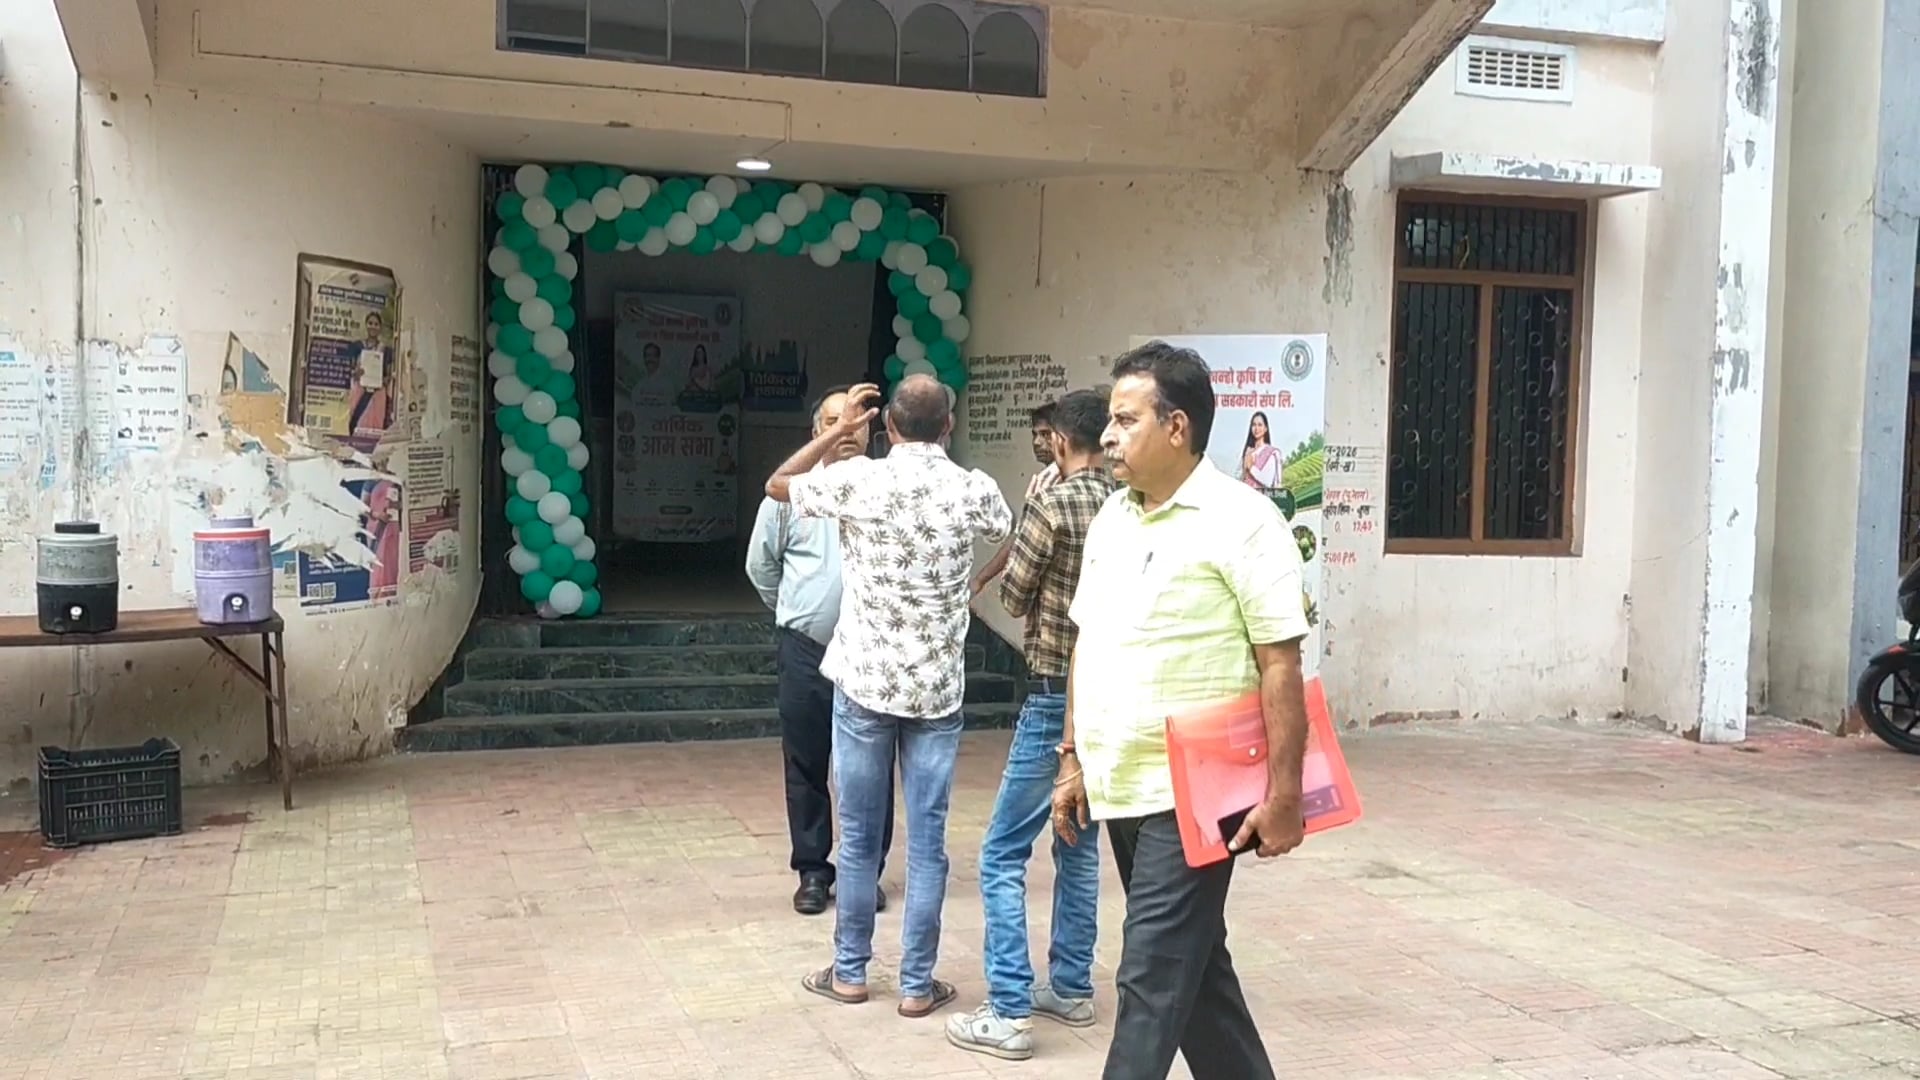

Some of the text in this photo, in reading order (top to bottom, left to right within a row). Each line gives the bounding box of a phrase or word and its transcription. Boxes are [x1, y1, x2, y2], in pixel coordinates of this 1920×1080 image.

[1236, 366, 1256, 389] कृषि
[1259, 367, 1272, 384] एवं
[1221, 390, 1257, 408] सहकारी
[1259, 389, 1276, 408] संघ
[1278, 390, 1295, 408] लि.
[652, 414, 704, 433] वार्षिक
[641, 435, 714, 457] आम सभा
